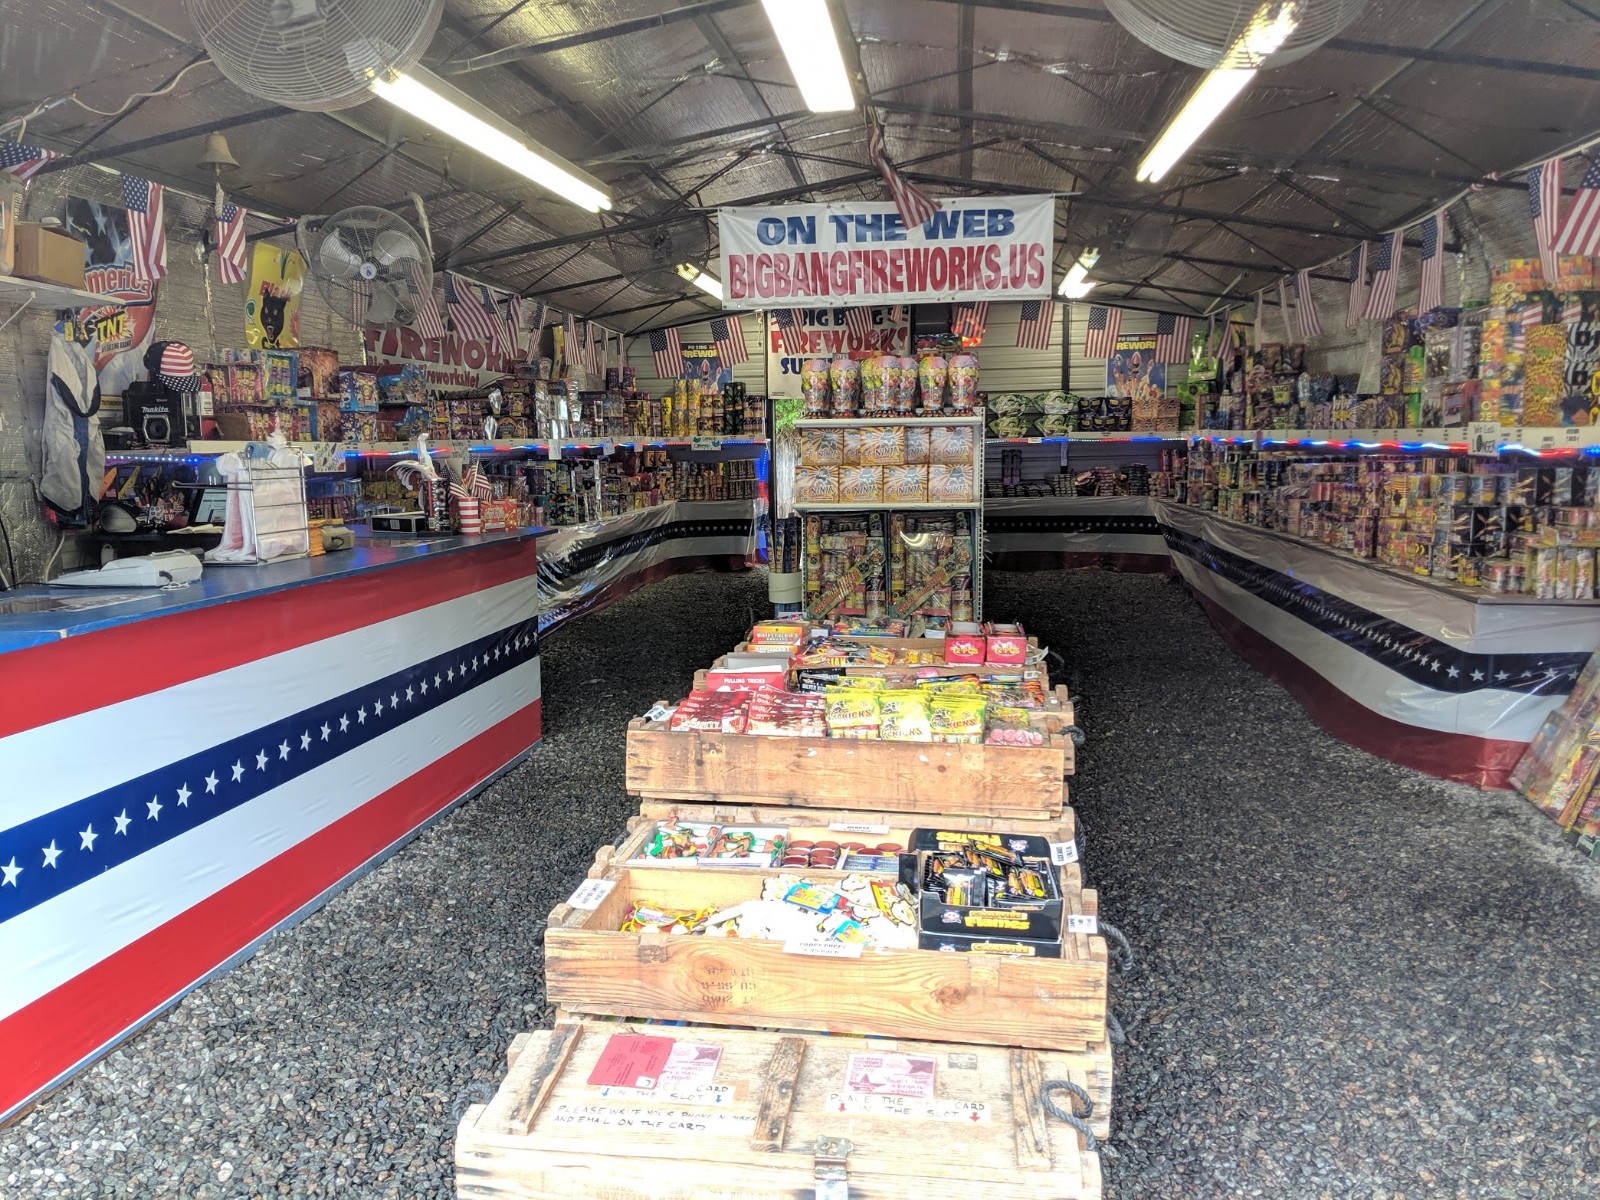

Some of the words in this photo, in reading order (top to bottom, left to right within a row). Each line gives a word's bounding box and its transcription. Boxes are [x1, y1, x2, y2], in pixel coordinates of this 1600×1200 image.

[756, 216, 816, 245] ON
[829, 213, 914, 244] THE
[923, 208, 1015, 241] WEB
[729, 242, 1045, 299] BIGBANGFIREWORKS.US
[86, 264, 152, 295] merica
[833, 307, 884, 327] BG
[97, 312, 127, 343] TNT
[771, 327, 908, 355] FREWORKS
[876, 447, 899, 456] NINJA
[812, 486, 834, 495] NINJA
[854, 485, 877, 495] NINJA
[964, 916, 1030, 930] Flames
[636, 1090, 658, 1098] THE
[670, 1093, 704, 1101] SLOT
[696, 1085, 729, 1093] CARD
[882, 1096, 904, 1106] THE
[955, 1102, 985, 1111] CARD
[558, 1105, 605, 1115] PLEASE
[609, 1107, 641, 1116] WRITE
[681, 1111, 713, 1120] PHONE
[886, 1107, 912, 1115] THE
[926, 1109, 960, 1118] SLOT
[554, 1115, 575, 1123] AND
[579, 1116, 610, 1125] EMAIL
[640, 1120, 664, 1129] THE
[669, 1122, 706, 1131] CARD
